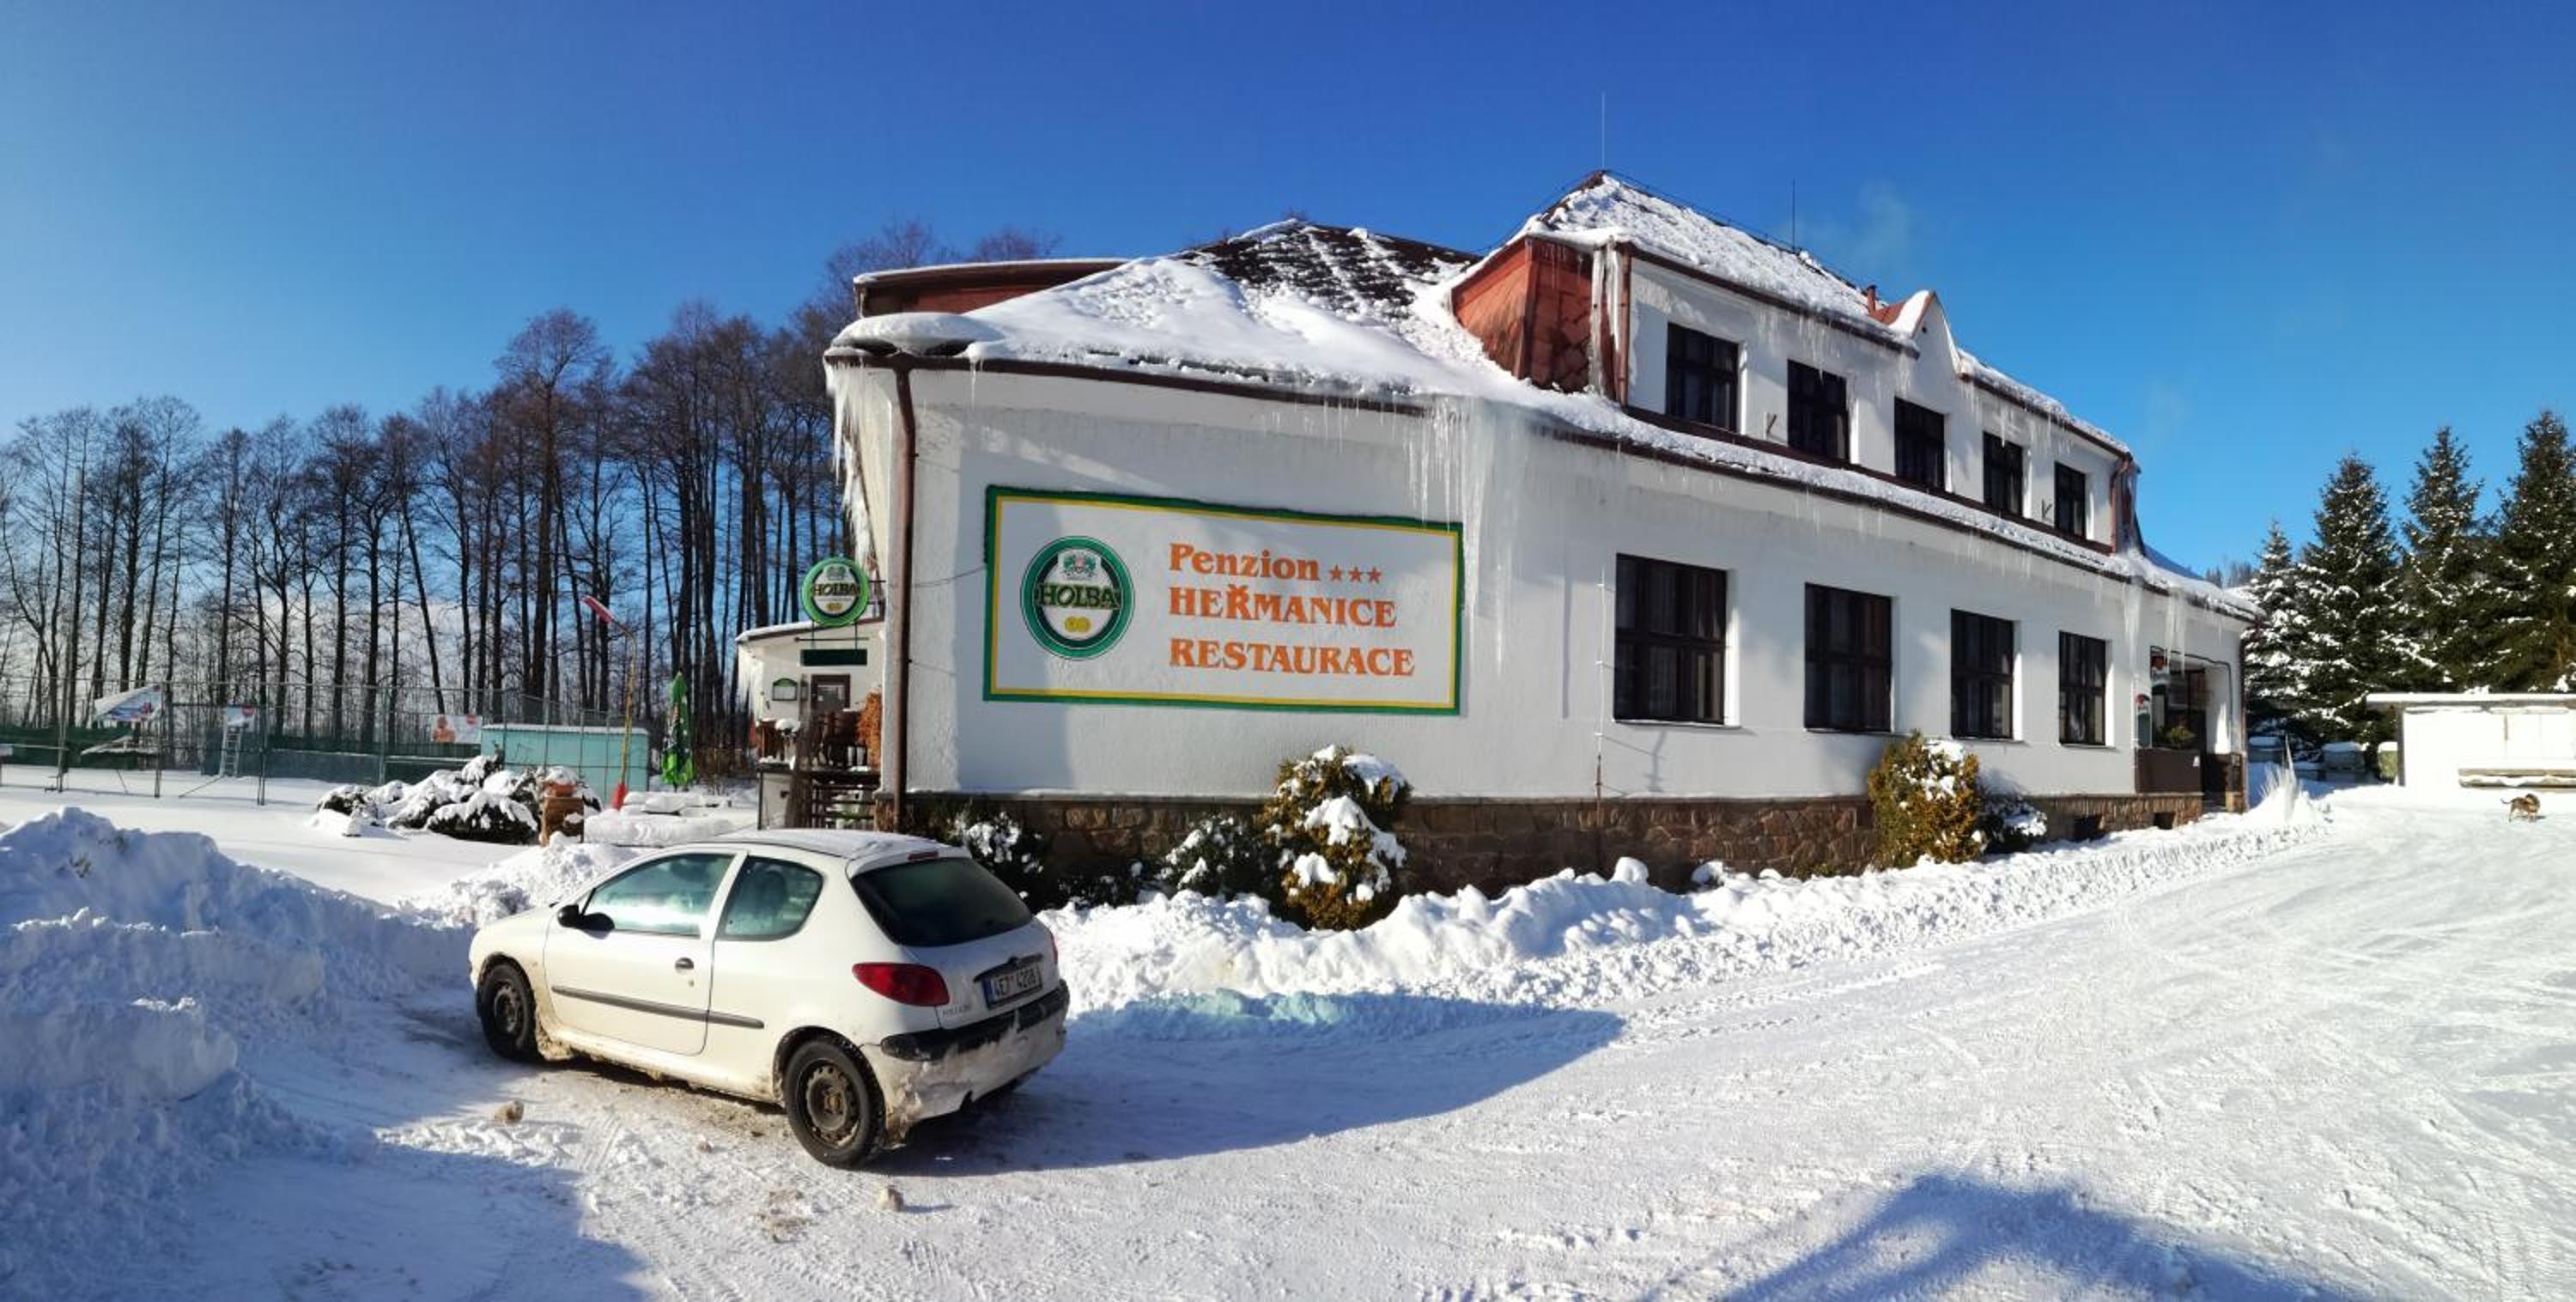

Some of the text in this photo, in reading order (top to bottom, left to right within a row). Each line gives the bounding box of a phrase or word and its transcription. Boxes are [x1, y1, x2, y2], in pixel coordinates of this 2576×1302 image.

[1169, 543, 1321, 581] Penzion
[811, 582, 861, 596] HOLBA
[1034, 582, 1121, 610] HOLBA
[1169, 583, 1397, 628] HEŘMANICE
[1169, 637, 1415, 676] RESTAURACE
